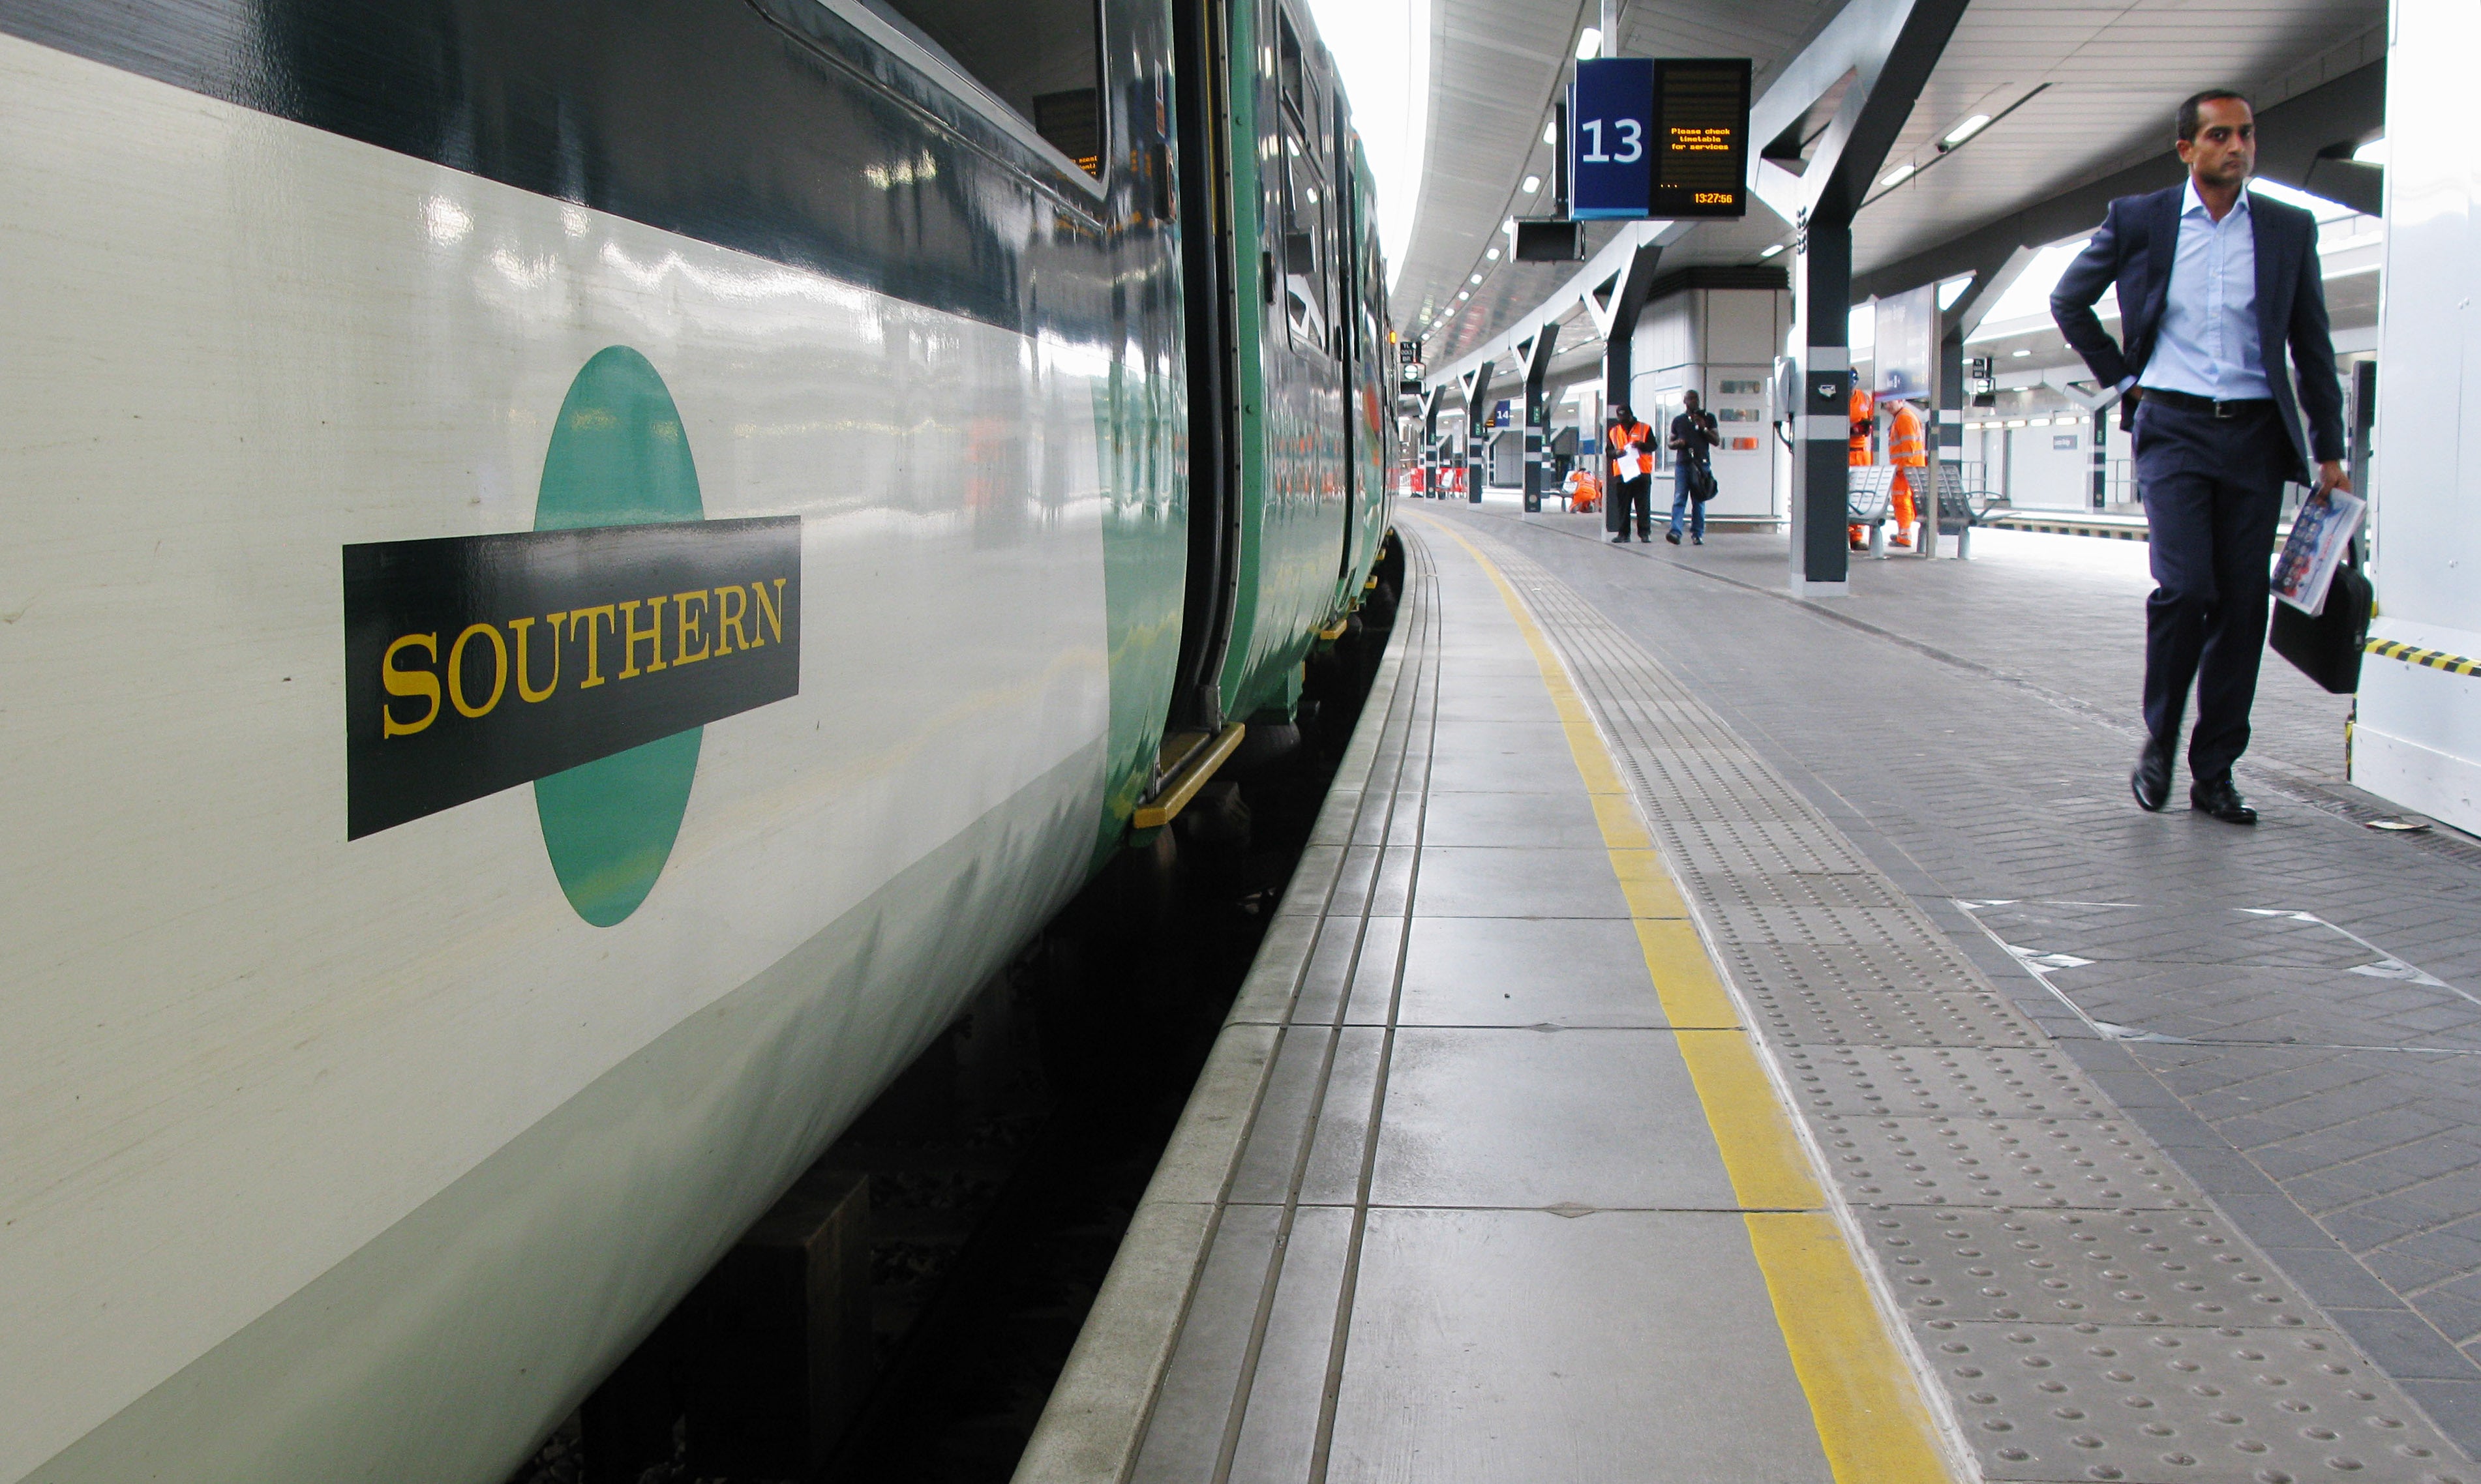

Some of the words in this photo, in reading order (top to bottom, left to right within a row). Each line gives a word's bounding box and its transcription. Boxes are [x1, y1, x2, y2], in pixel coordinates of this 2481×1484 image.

[1582, 119, 1642, 162] 13
[1694, 193, 1732, 203] 13:27:56
[1497, 410, 1509, 419] 14
[382, 578, 787, 739] SOUTHERN
